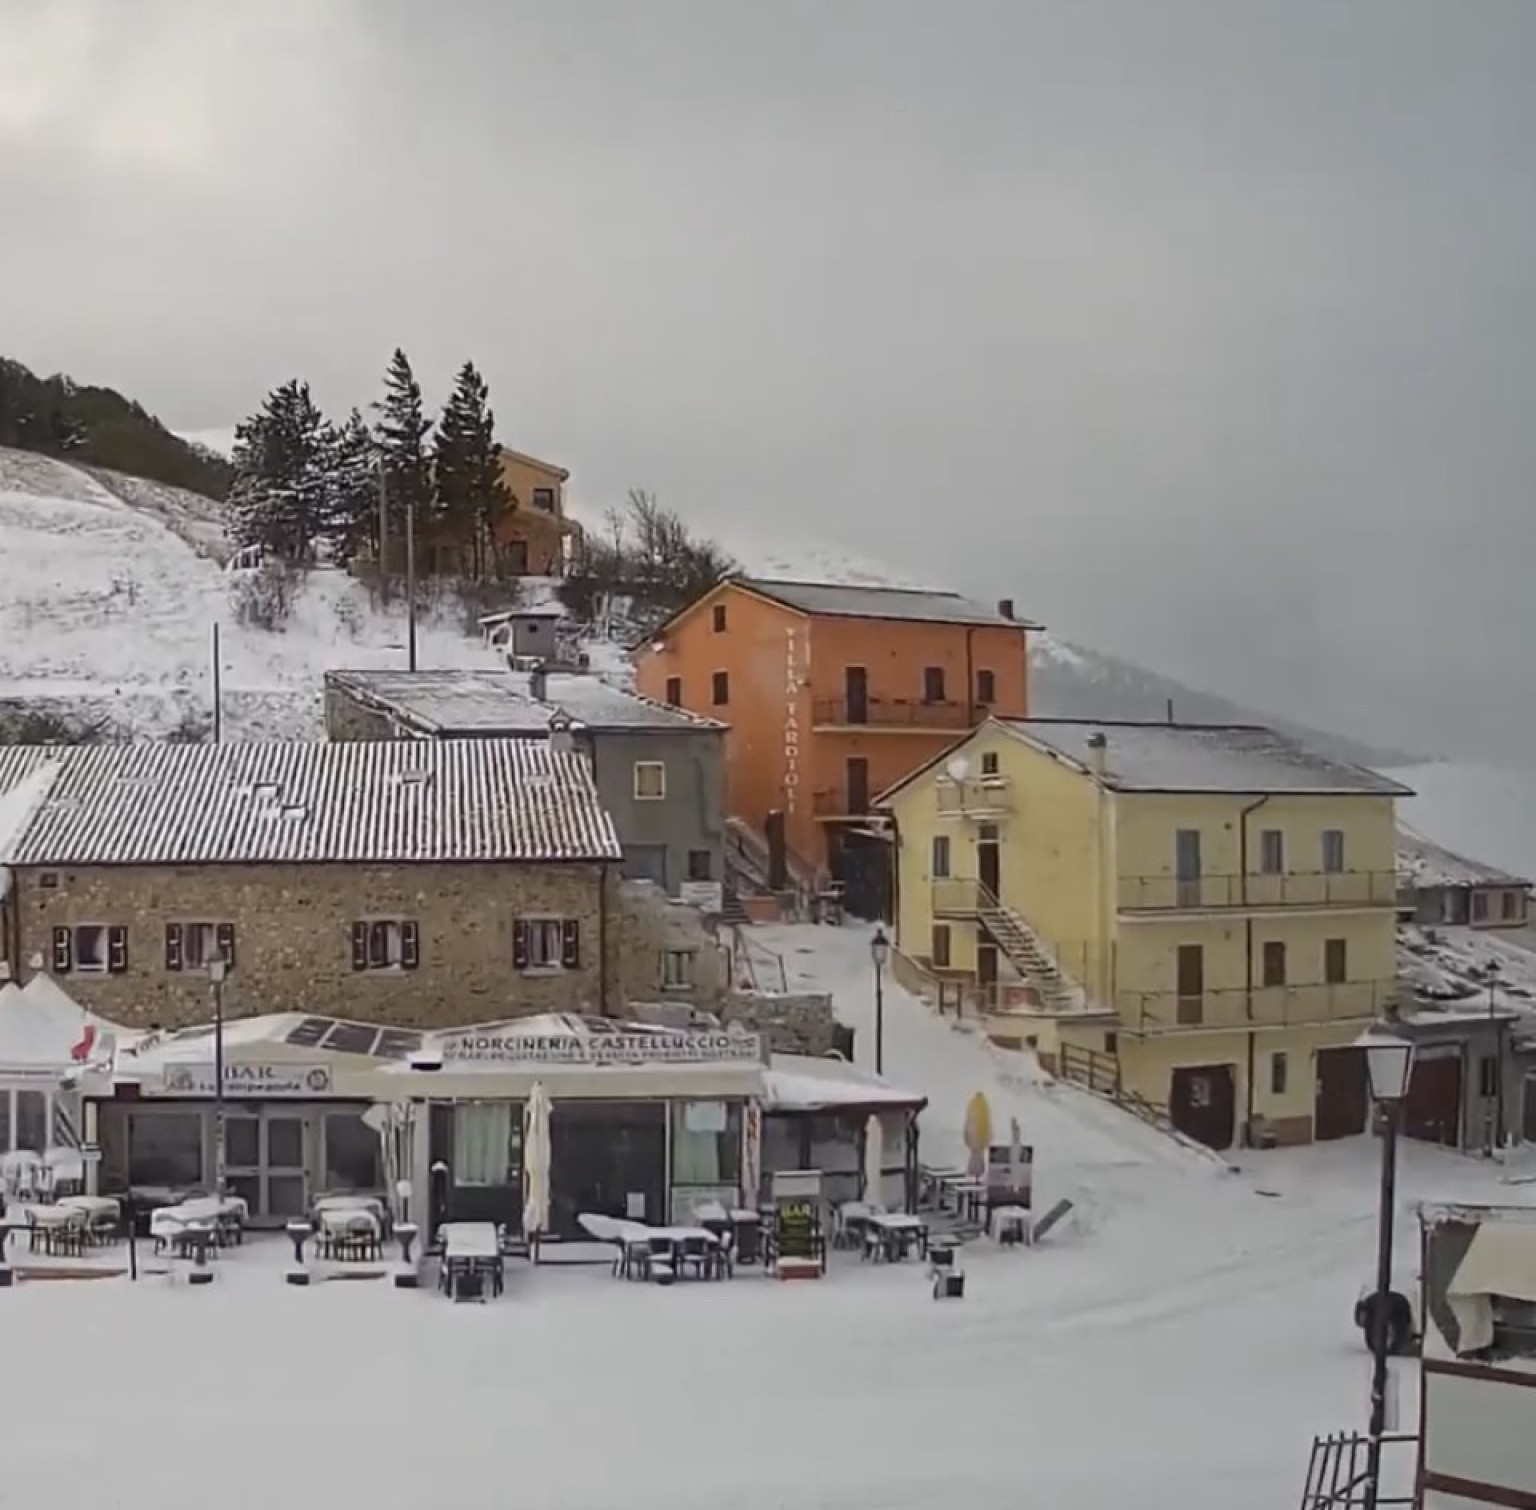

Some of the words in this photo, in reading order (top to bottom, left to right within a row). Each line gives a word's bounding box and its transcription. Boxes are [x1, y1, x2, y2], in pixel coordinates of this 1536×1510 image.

[785, 627, 799, 694] VILLA
[785, 703, 799, 815] TARDIOLI
[463, 1037, 580, 1050] NORCINERIA
[588, 1035, 729, 1049] CASTELLUCCIO
[224, 1066, 276, 1079] BAR
[780, 1203, 811, 1217] BAR
